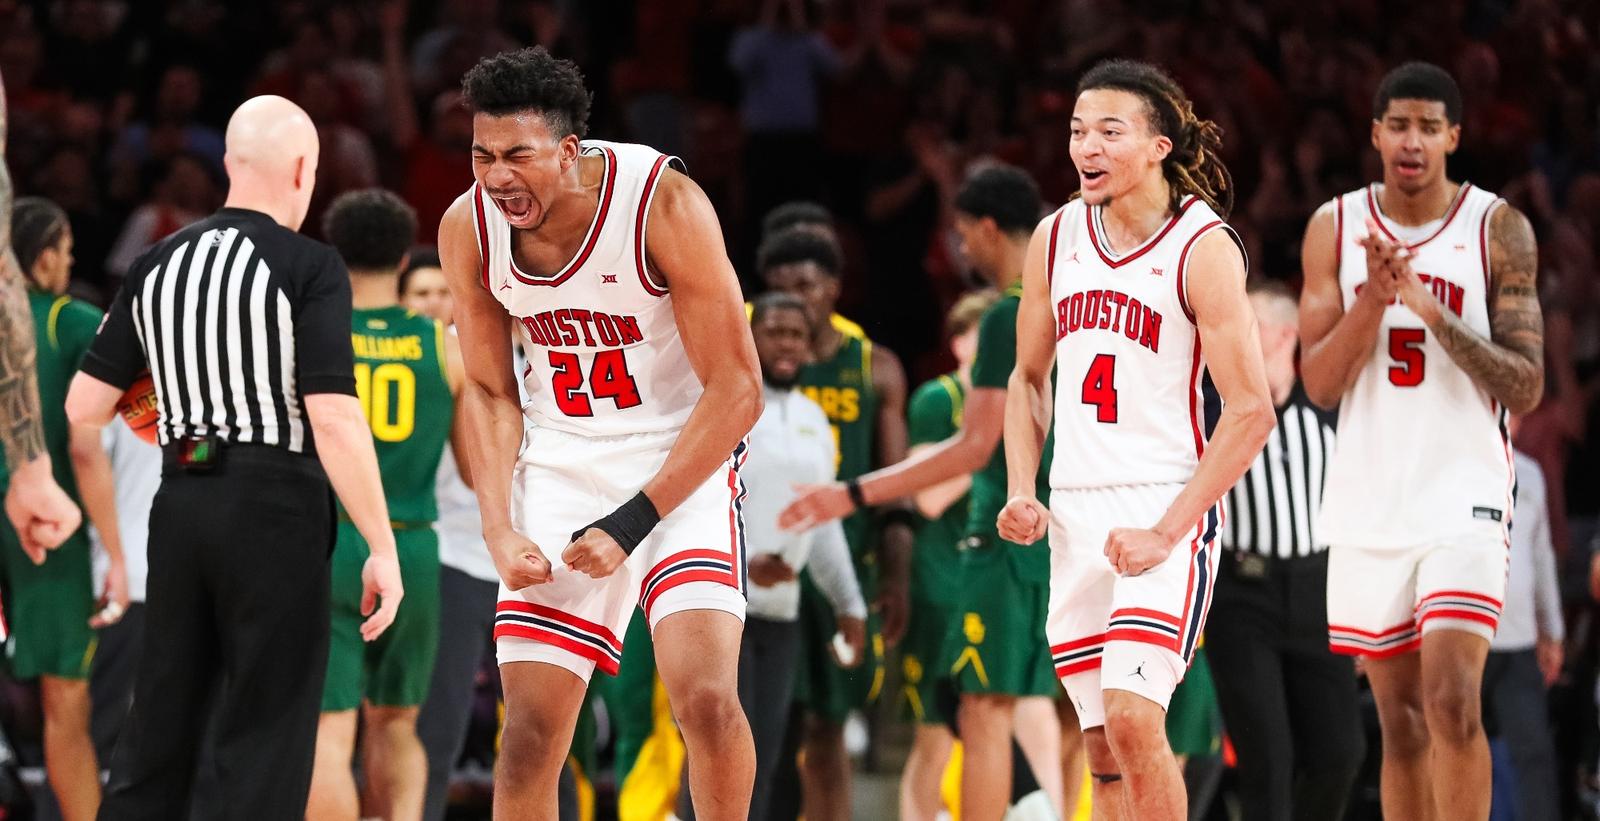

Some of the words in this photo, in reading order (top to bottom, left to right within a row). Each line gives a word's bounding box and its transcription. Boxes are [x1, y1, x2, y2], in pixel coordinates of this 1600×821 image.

[522, 308, 643, 347] OUSTON
[1056, 290, 1162, 353] HOUSTON
[548, 348, 642, 417] 24
[1081, 353, 1117, 424] 4
[1388, 327, 1425, 387] 5
